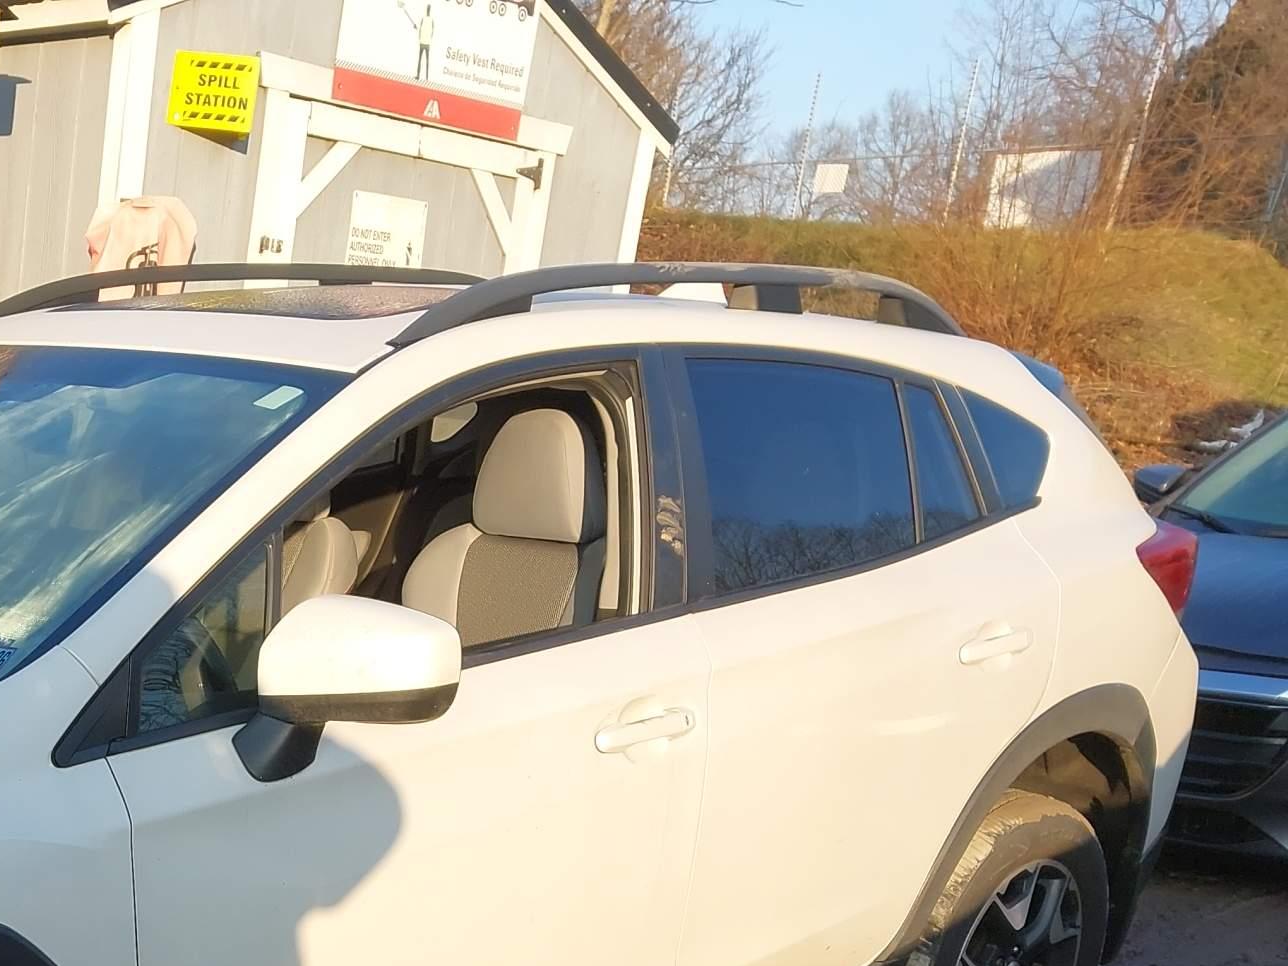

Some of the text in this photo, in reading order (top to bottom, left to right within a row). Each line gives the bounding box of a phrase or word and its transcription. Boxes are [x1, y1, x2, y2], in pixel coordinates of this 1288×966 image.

[446, 46, 524, 77] Safety Vest Required
[198, 74, 240, 89] SPILL
[185, 92, 248, 110] STATION
[351, 226, 391, 242] DO NOT ENTER
[350, 241, 384, 254] AUTHORIZED
